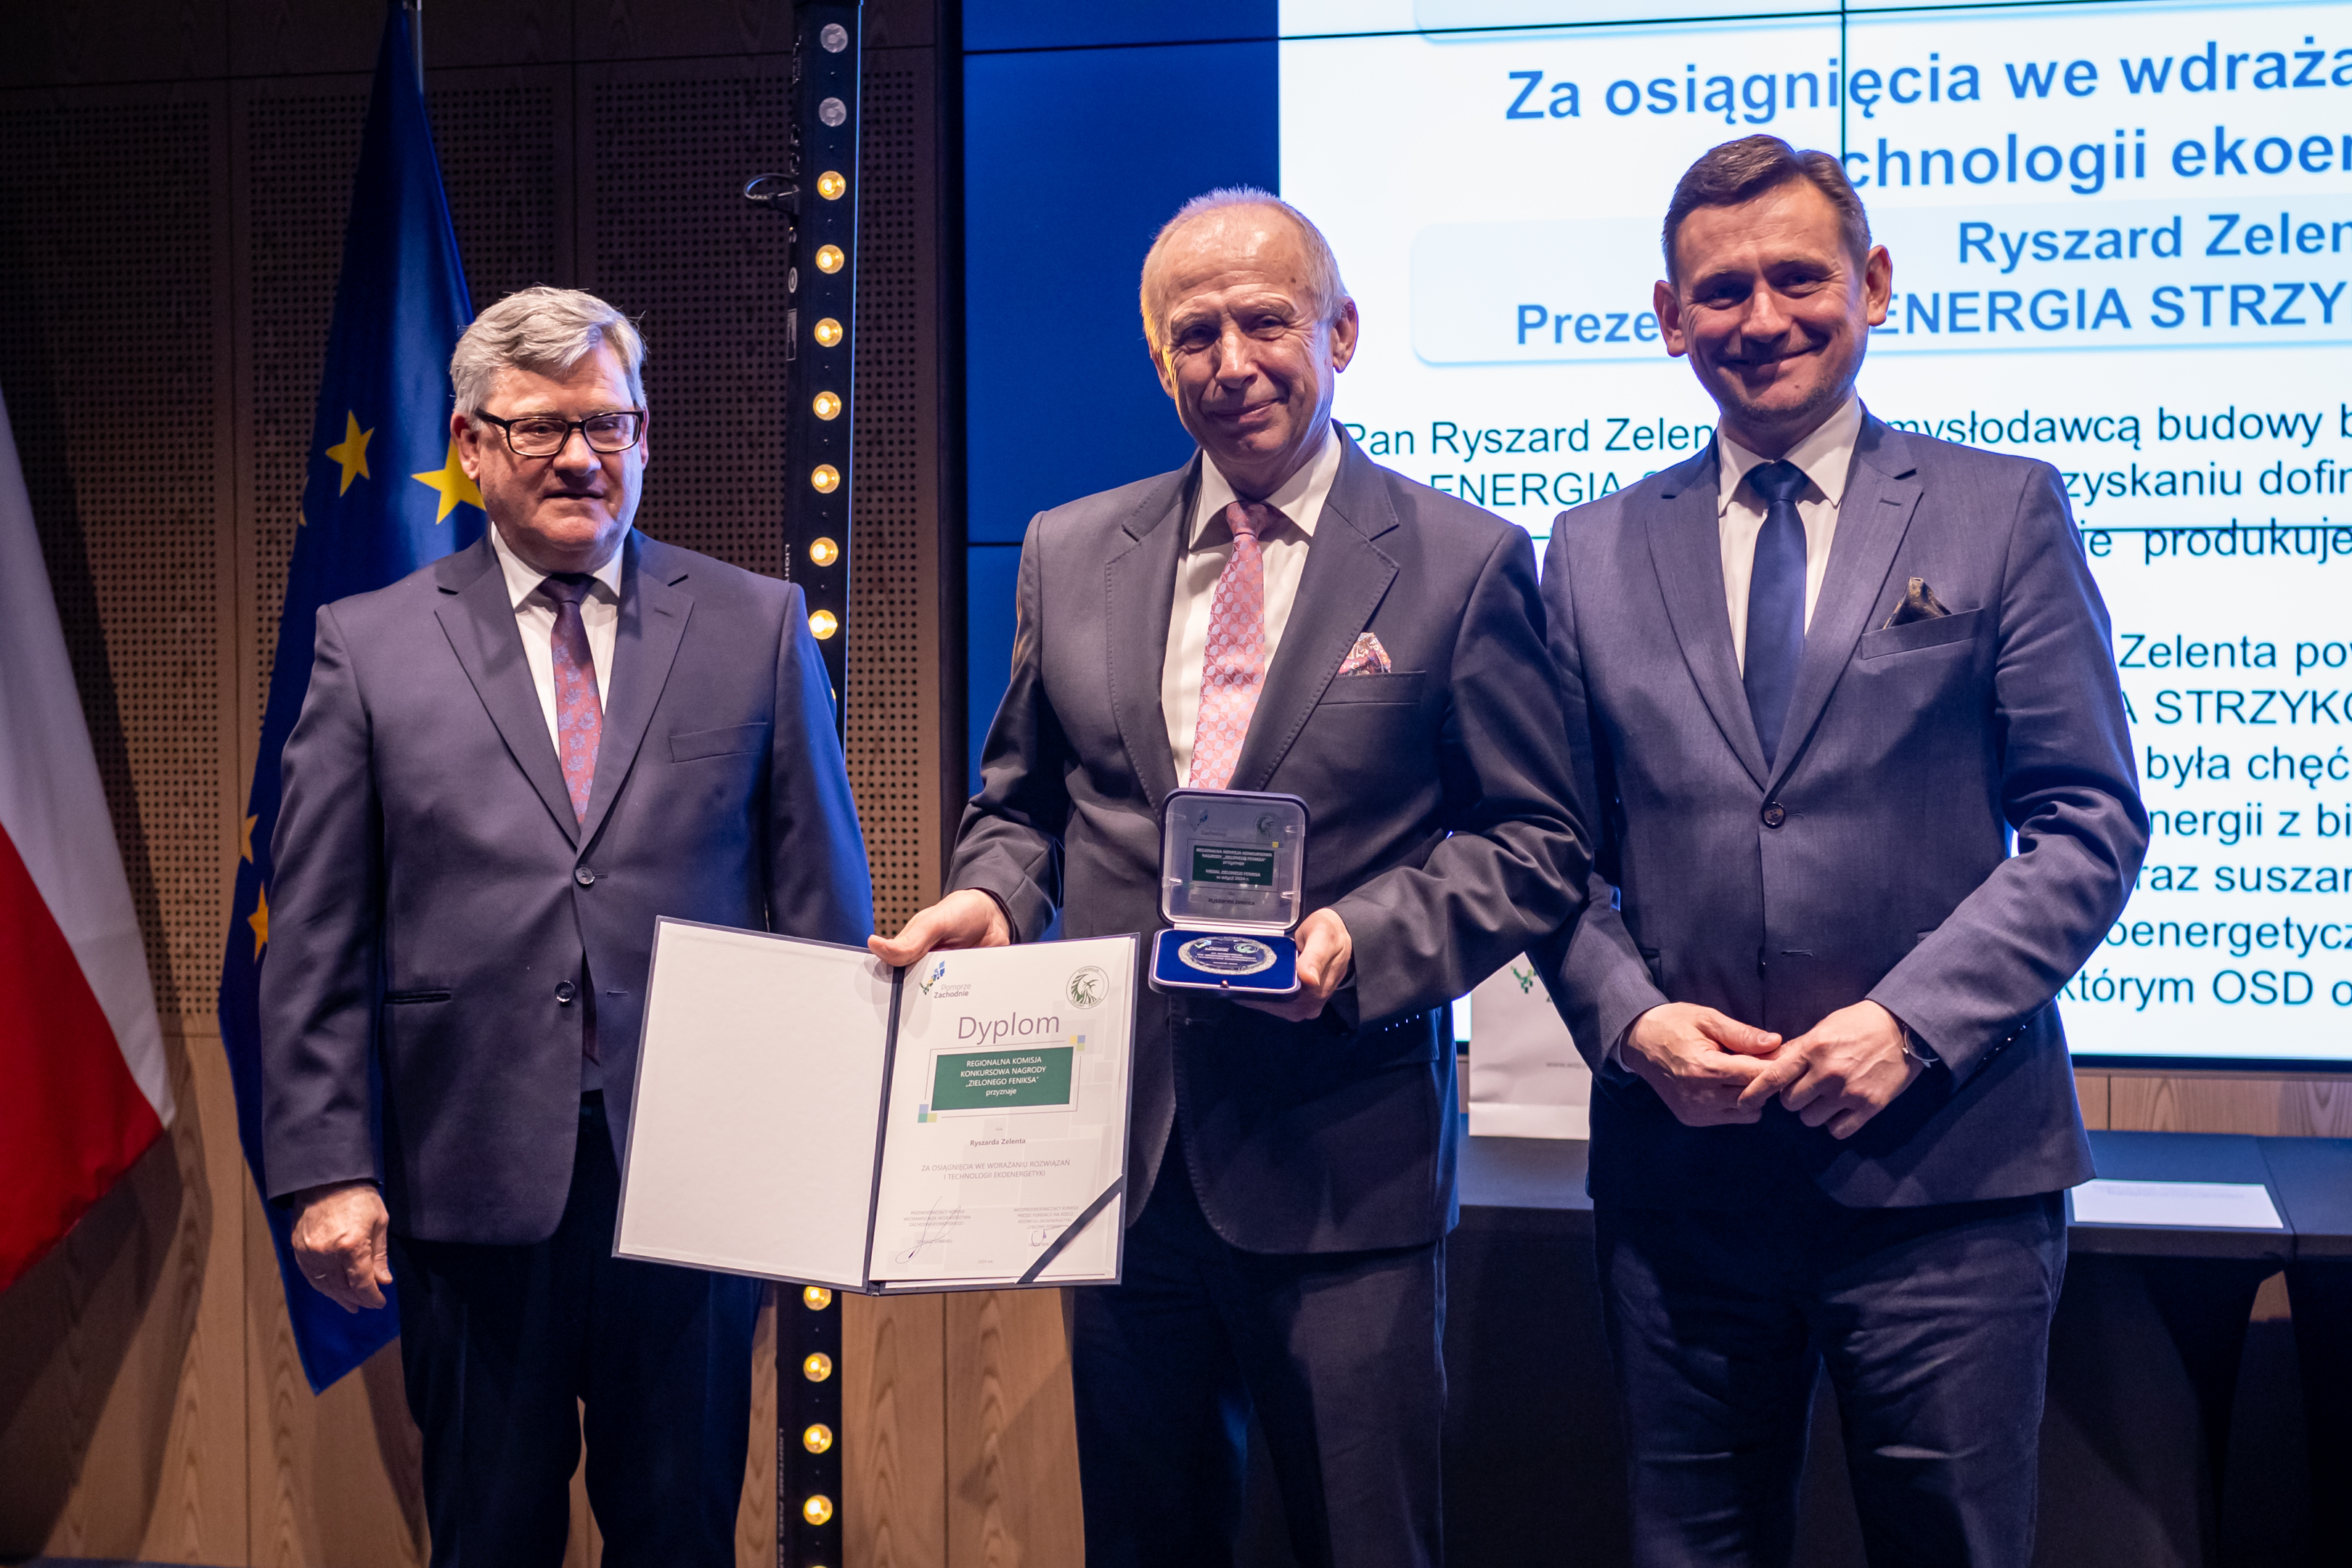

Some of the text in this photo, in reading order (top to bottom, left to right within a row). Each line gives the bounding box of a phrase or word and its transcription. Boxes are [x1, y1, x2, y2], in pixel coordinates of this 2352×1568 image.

[1506, 70, 1581, 120] Za
[1605, 53, 1980, 125] osiągnięcia
[2005, 57, 2098, 99] we
[2171, 125, 2352, 177] ekoe
[1959, 216, 2181, 274] Ryszard
[1517, 305, 1659, 345] Preze
[2151, 281, 2352, 329] STRZY
[1432, 420, 1589, 462] Ryszard
[2159, 406, 2322, 446] budowy
[2119, 634, 2352, 676] Zelenta po
[2155, 690, 2352, 724] STRZYK
[2147, 746, 2350, 789] była chęć
[2278, 812, 2300, 836] z
[2213, 970, 2314, 1005] OSD
[958, 1012, 1059, 1045] Dyplom
[960, 1066, 1047, 1077] KONKURSOWA NAGRODY
[966, 1058, 1010, 1067] REGIONALNA
[985, 1087, 1017, 1097] przyznaje
[970, 1138, 1000, 1147] Ryszarda
[931, 1164, 973, 1172] OSIĄGNIĘCIA
[1029, 1159, 1071, 1167] ROZWIĄZAŃ
